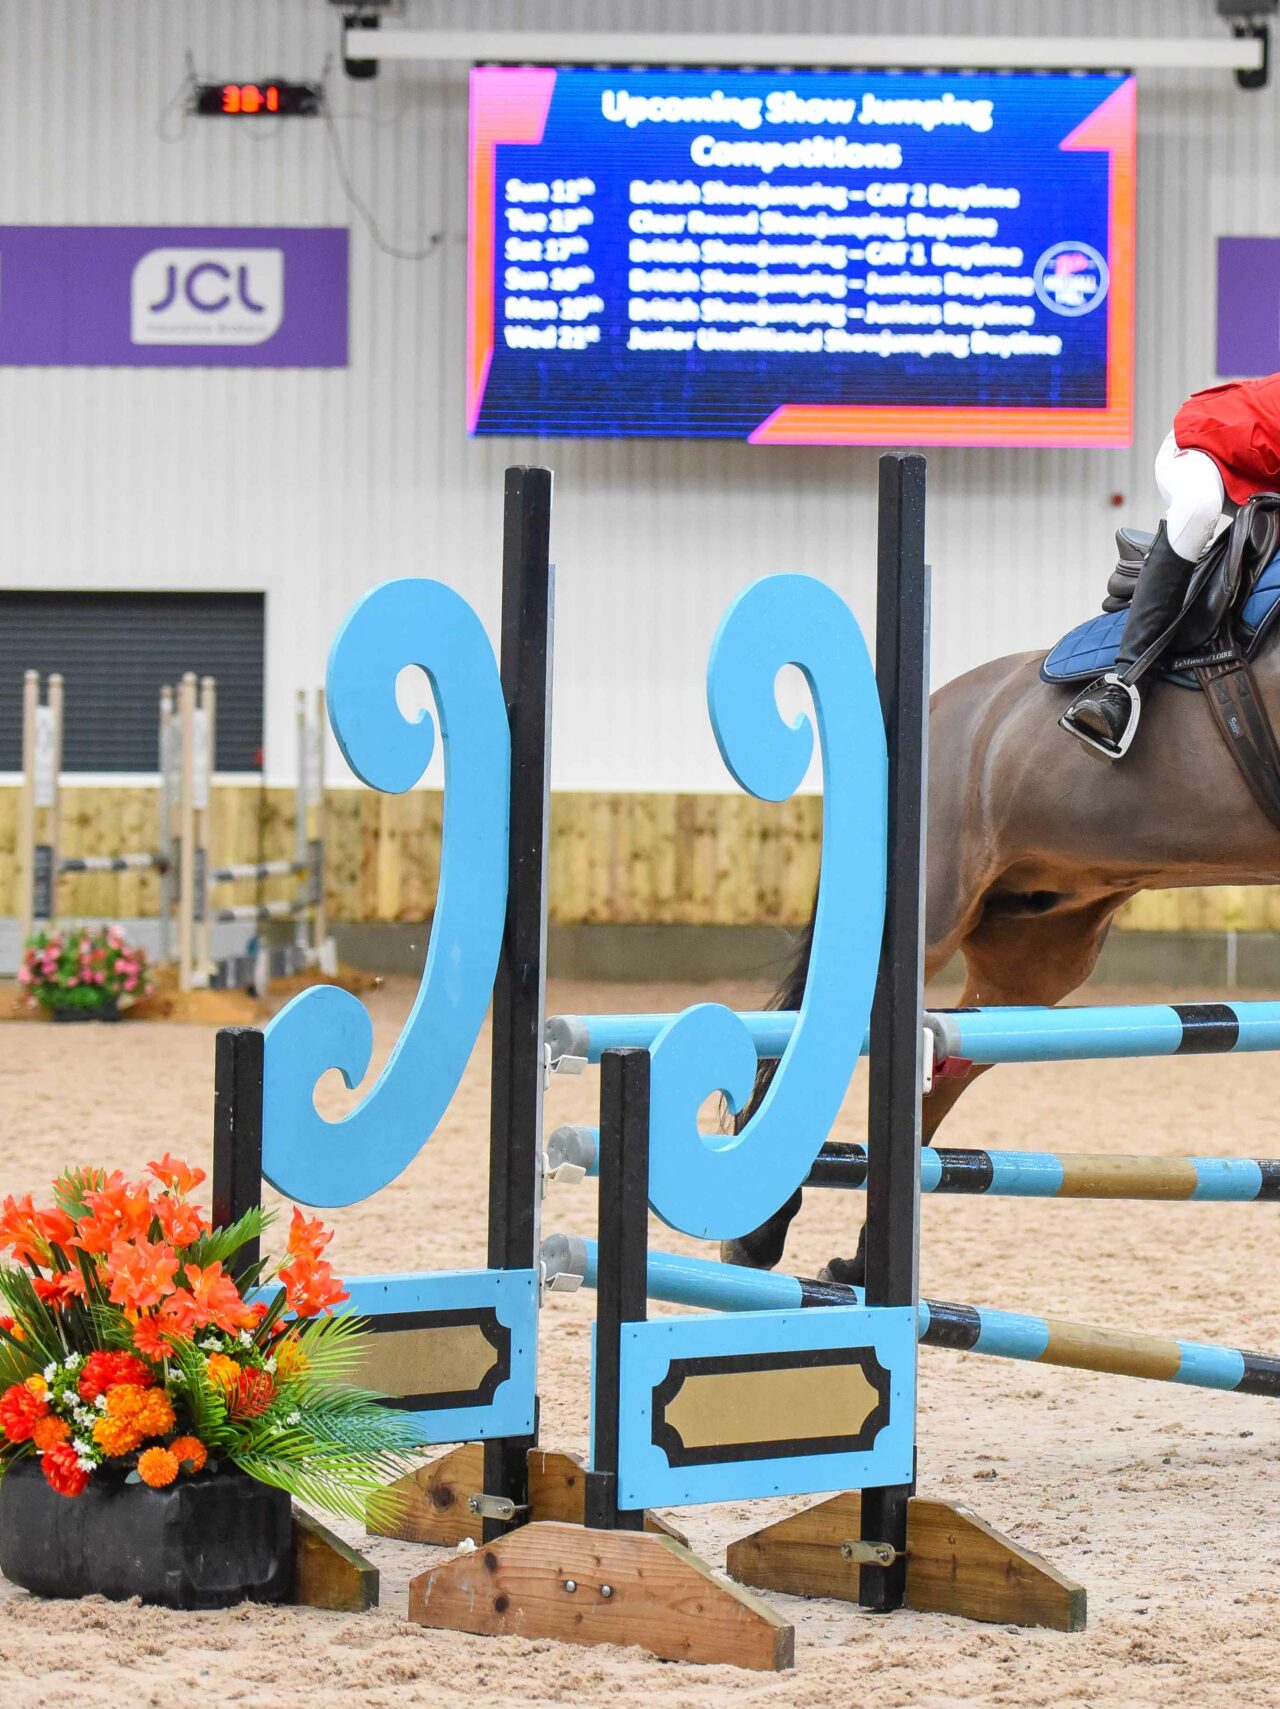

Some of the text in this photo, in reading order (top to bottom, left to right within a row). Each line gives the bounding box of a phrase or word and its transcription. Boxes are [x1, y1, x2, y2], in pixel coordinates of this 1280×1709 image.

[602, 90, 993, 132] Upcoming Show Jumping
[691, 135, 902, 173] Competitions
[149, 262, 264, 313] JCL
